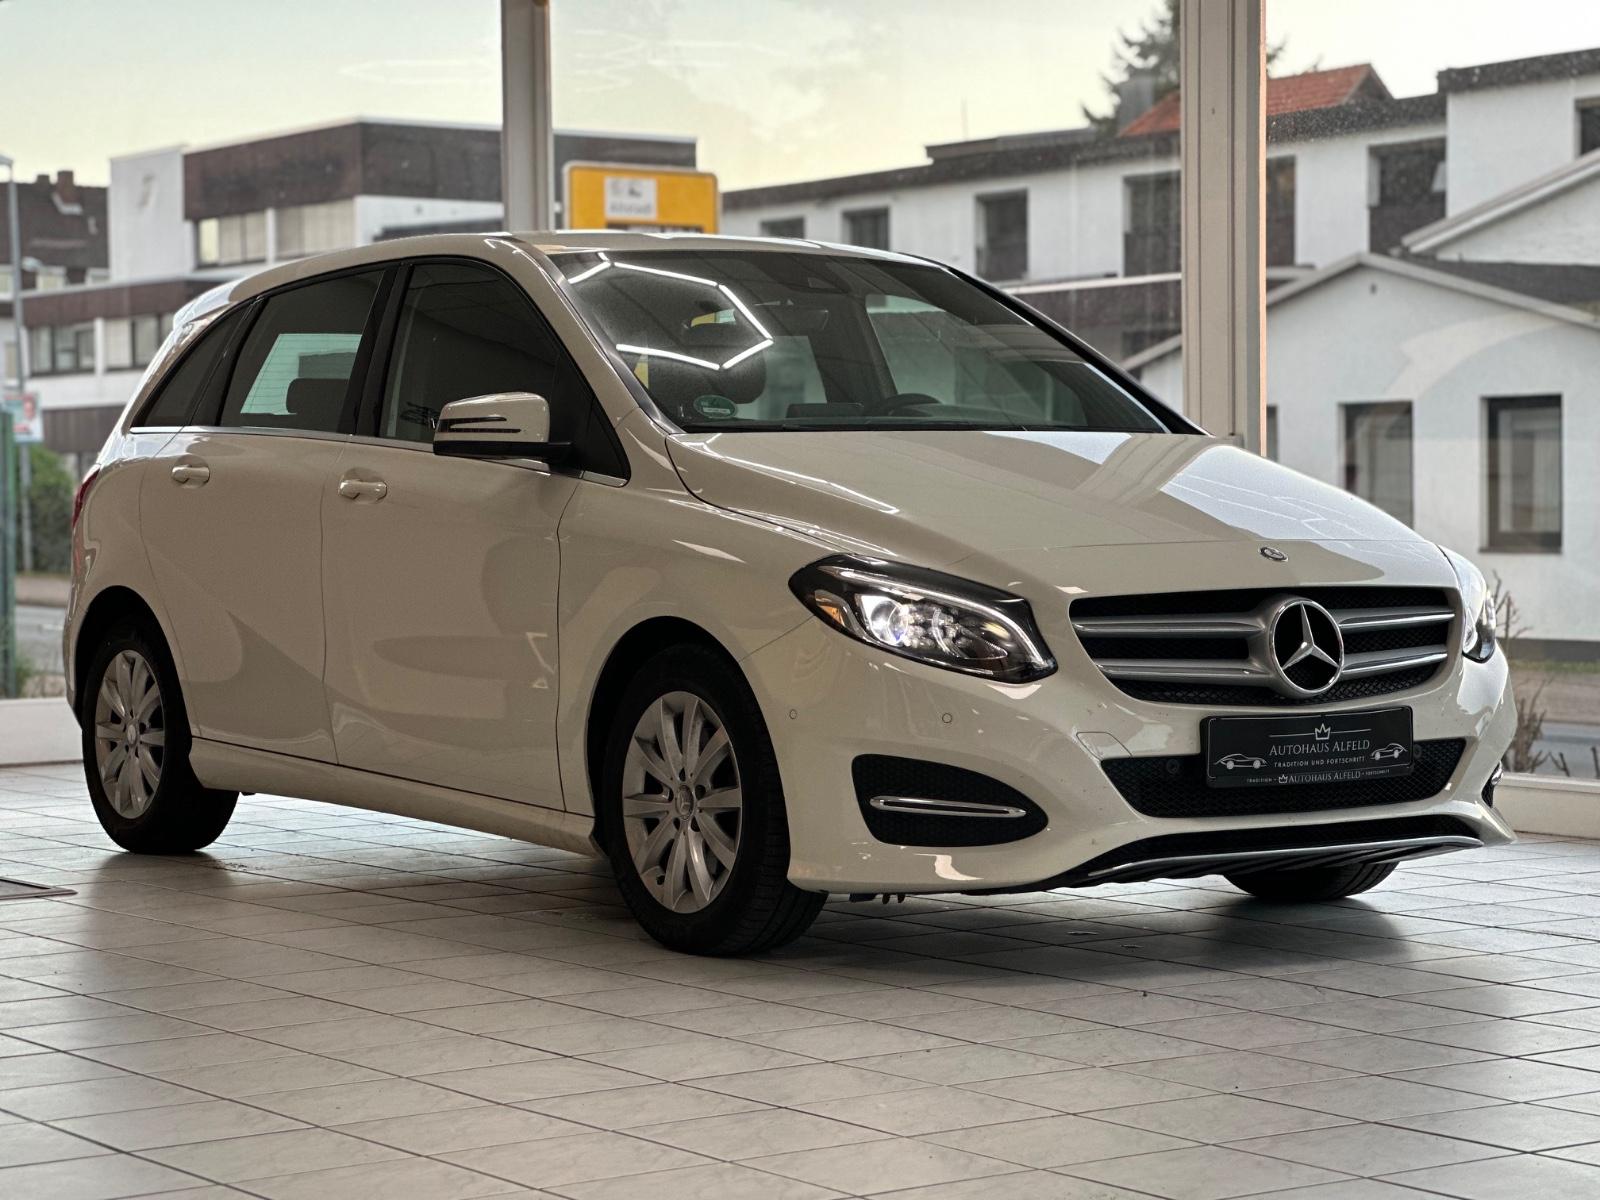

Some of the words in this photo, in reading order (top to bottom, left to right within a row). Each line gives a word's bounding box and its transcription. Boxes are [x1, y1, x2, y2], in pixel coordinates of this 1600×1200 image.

[1269, 743, 1330, 756] AUTOHAUS
[1332, 740, 1370, 752] ALFELD
[1274, 760, 1309, 768] TRADITION
[1326, 756, 1365, 765] FORTSCHRITT
[1288, 772, 1332, 784] AUTOHAUS
[1333, 771, 1361, 780] ALFELD
